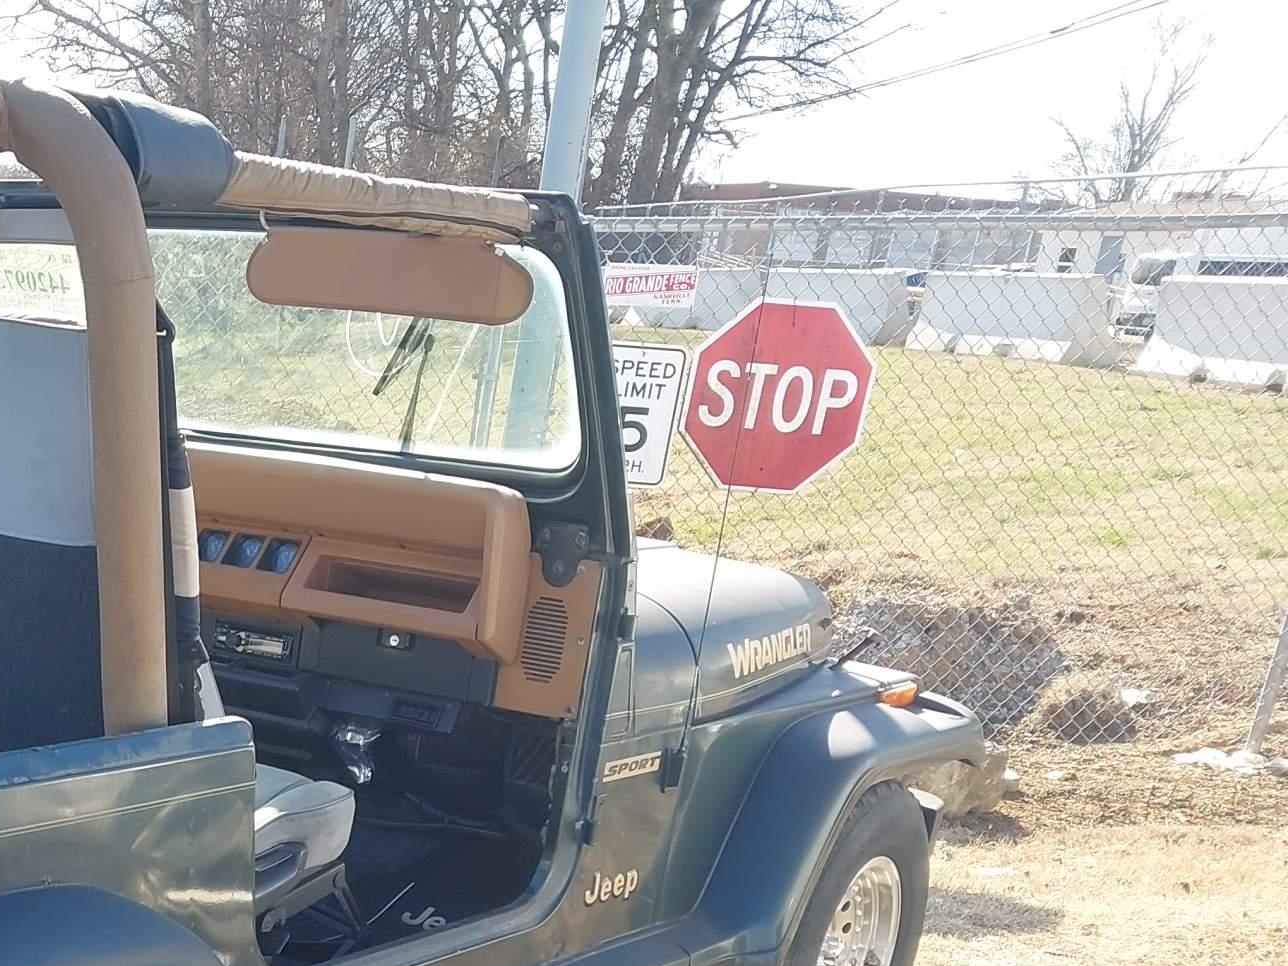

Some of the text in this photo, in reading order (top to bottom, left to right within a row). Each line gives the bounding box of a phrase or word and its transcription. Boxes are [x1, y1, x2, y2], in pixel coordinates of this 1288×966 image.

[605, 272, 696, 294] RIO GRANDE FENCE
[698, 359, 859, 436] STOP
[726, 622, 813, 679] WRANGLER
[606, 755, 661, 778] SPORT
[584, 868, 639, 906] Jeep
